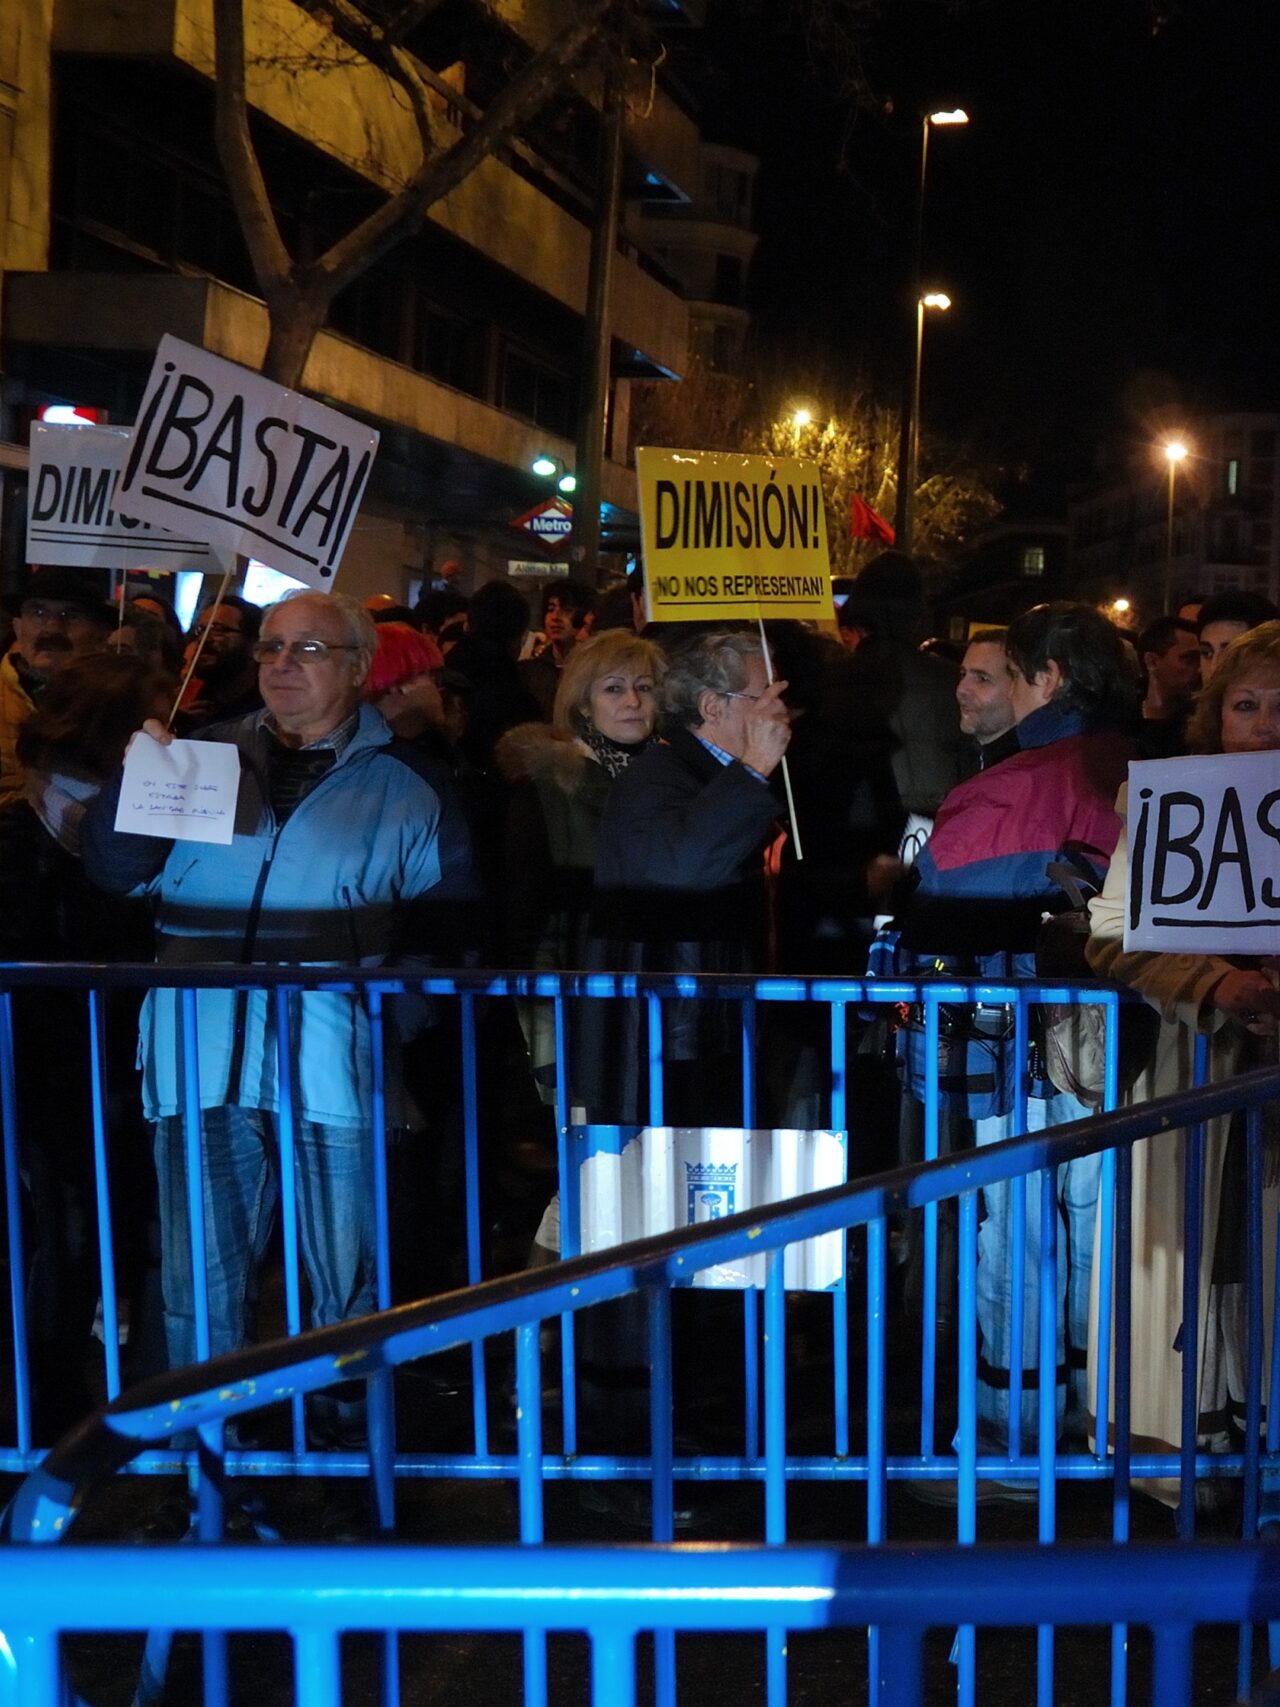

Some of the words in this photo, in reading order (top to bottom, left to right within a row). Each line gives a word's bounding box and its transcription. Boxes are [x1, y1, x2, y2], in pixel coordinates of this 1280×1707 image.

[121, 362, 372, 577] ¡BASTA!
[533, 518, 572, 532] Metro
[656, 469, 819, 549] DIMISIÓN!
[684, 575, 718, 597] NOS
[722, 575, 824, 597] REPRESENTAN!
